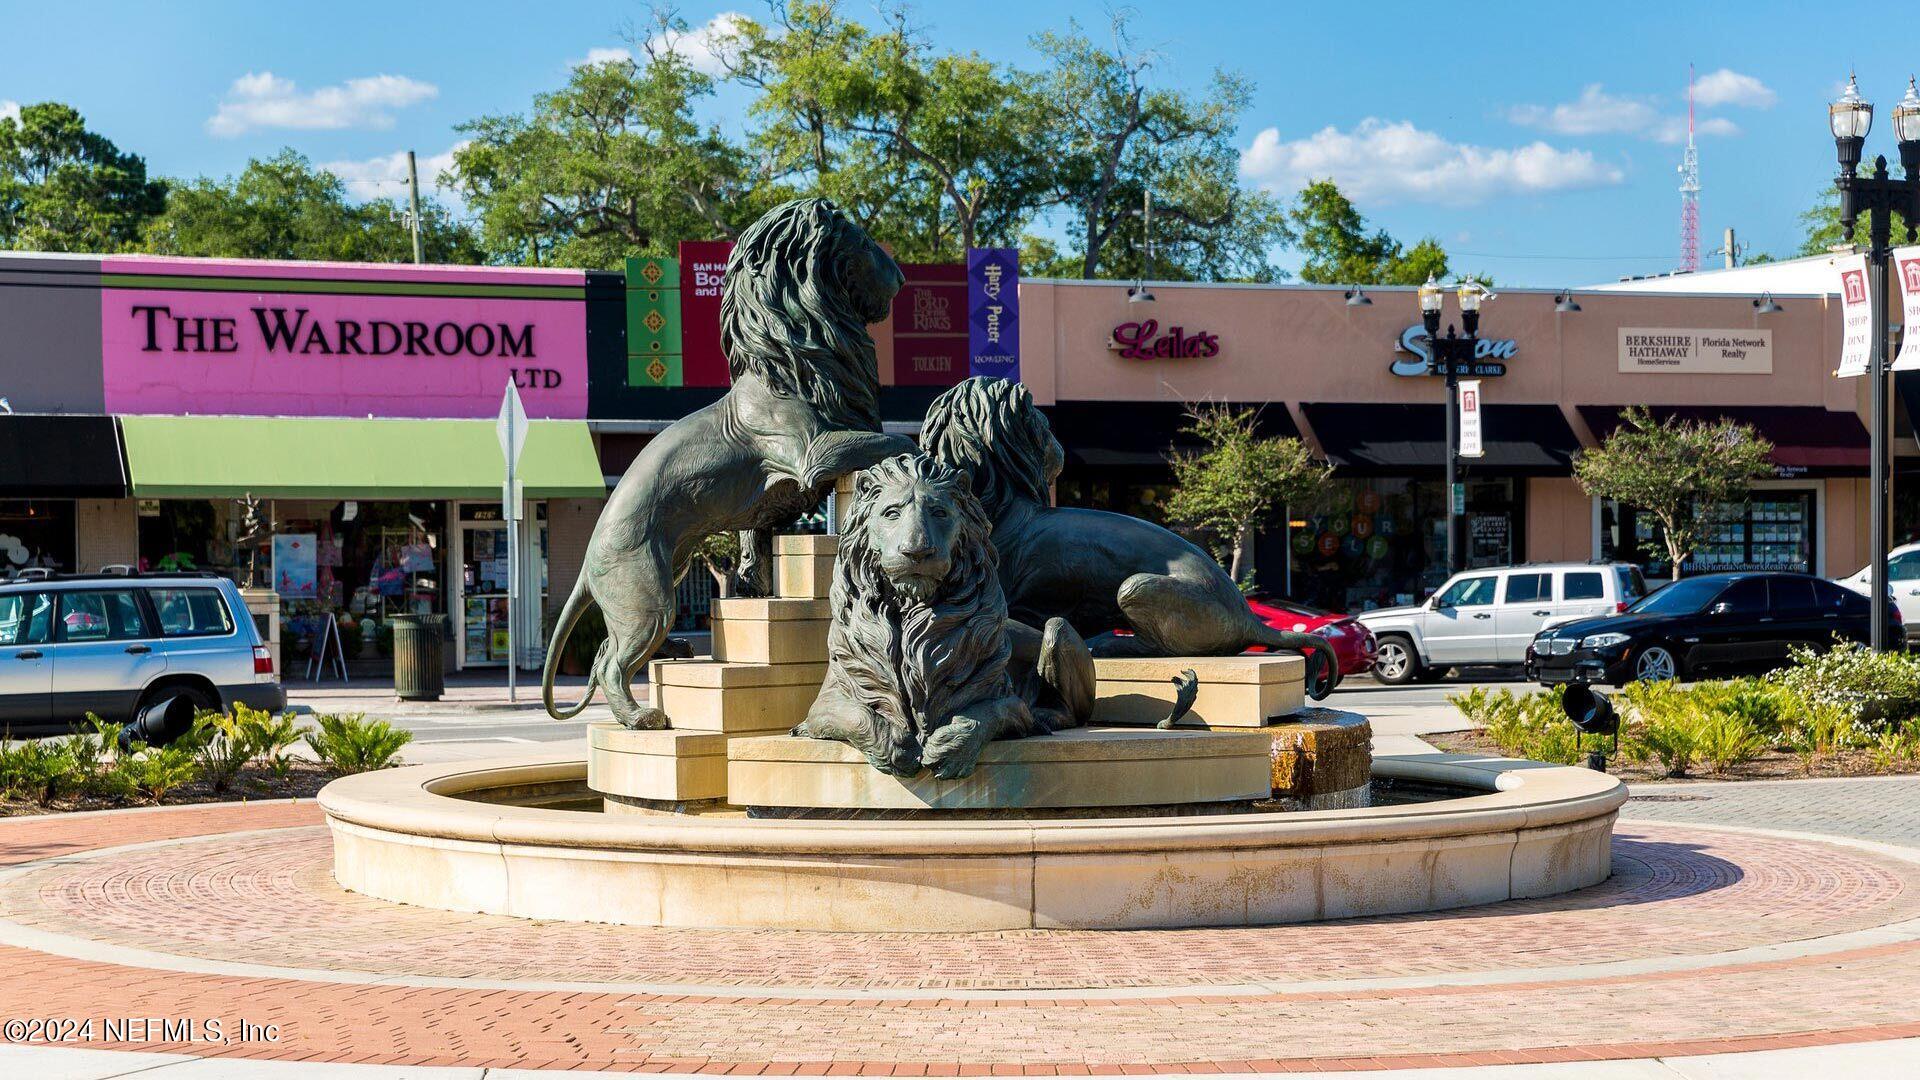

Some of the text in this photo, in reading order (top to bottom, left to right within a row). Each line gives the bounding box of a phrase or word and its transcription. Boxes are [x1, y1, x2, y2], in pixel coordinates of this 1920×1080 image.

[693, 262, 728, 271] SAN MA
[695, 286, 717, 297] and
[913, 294, 949, 312] LORD
[984, 263, 1003, 343] Harry Potter
[1908, 306, 1920, 316] SH
[913, 313, 951, 331] RINGS
[1848, 316, 1868, 326] SHOP
[131, 305, 537, 358] THE WARDROOM
[1113, 319, 1220, 360] Leila's
[1625, 335, 1691, 346] BERKSHIRE
[1702, 337, 1766, 348] Florida Network
[1848, 335, 1865, 345] DINE
[1629, 347, 1689, 357] HATHAWAY
[1722, 349, 1747, 360] Realty
[912, 356, 952, 371] TOLKIEN
[1637, 358, 1680, 366] HomeServices
[1475, 364, 1502, 374] CLARKE
[510, 368, 563, 389] LTD
[1301, 535, 1382, 553] SELF
